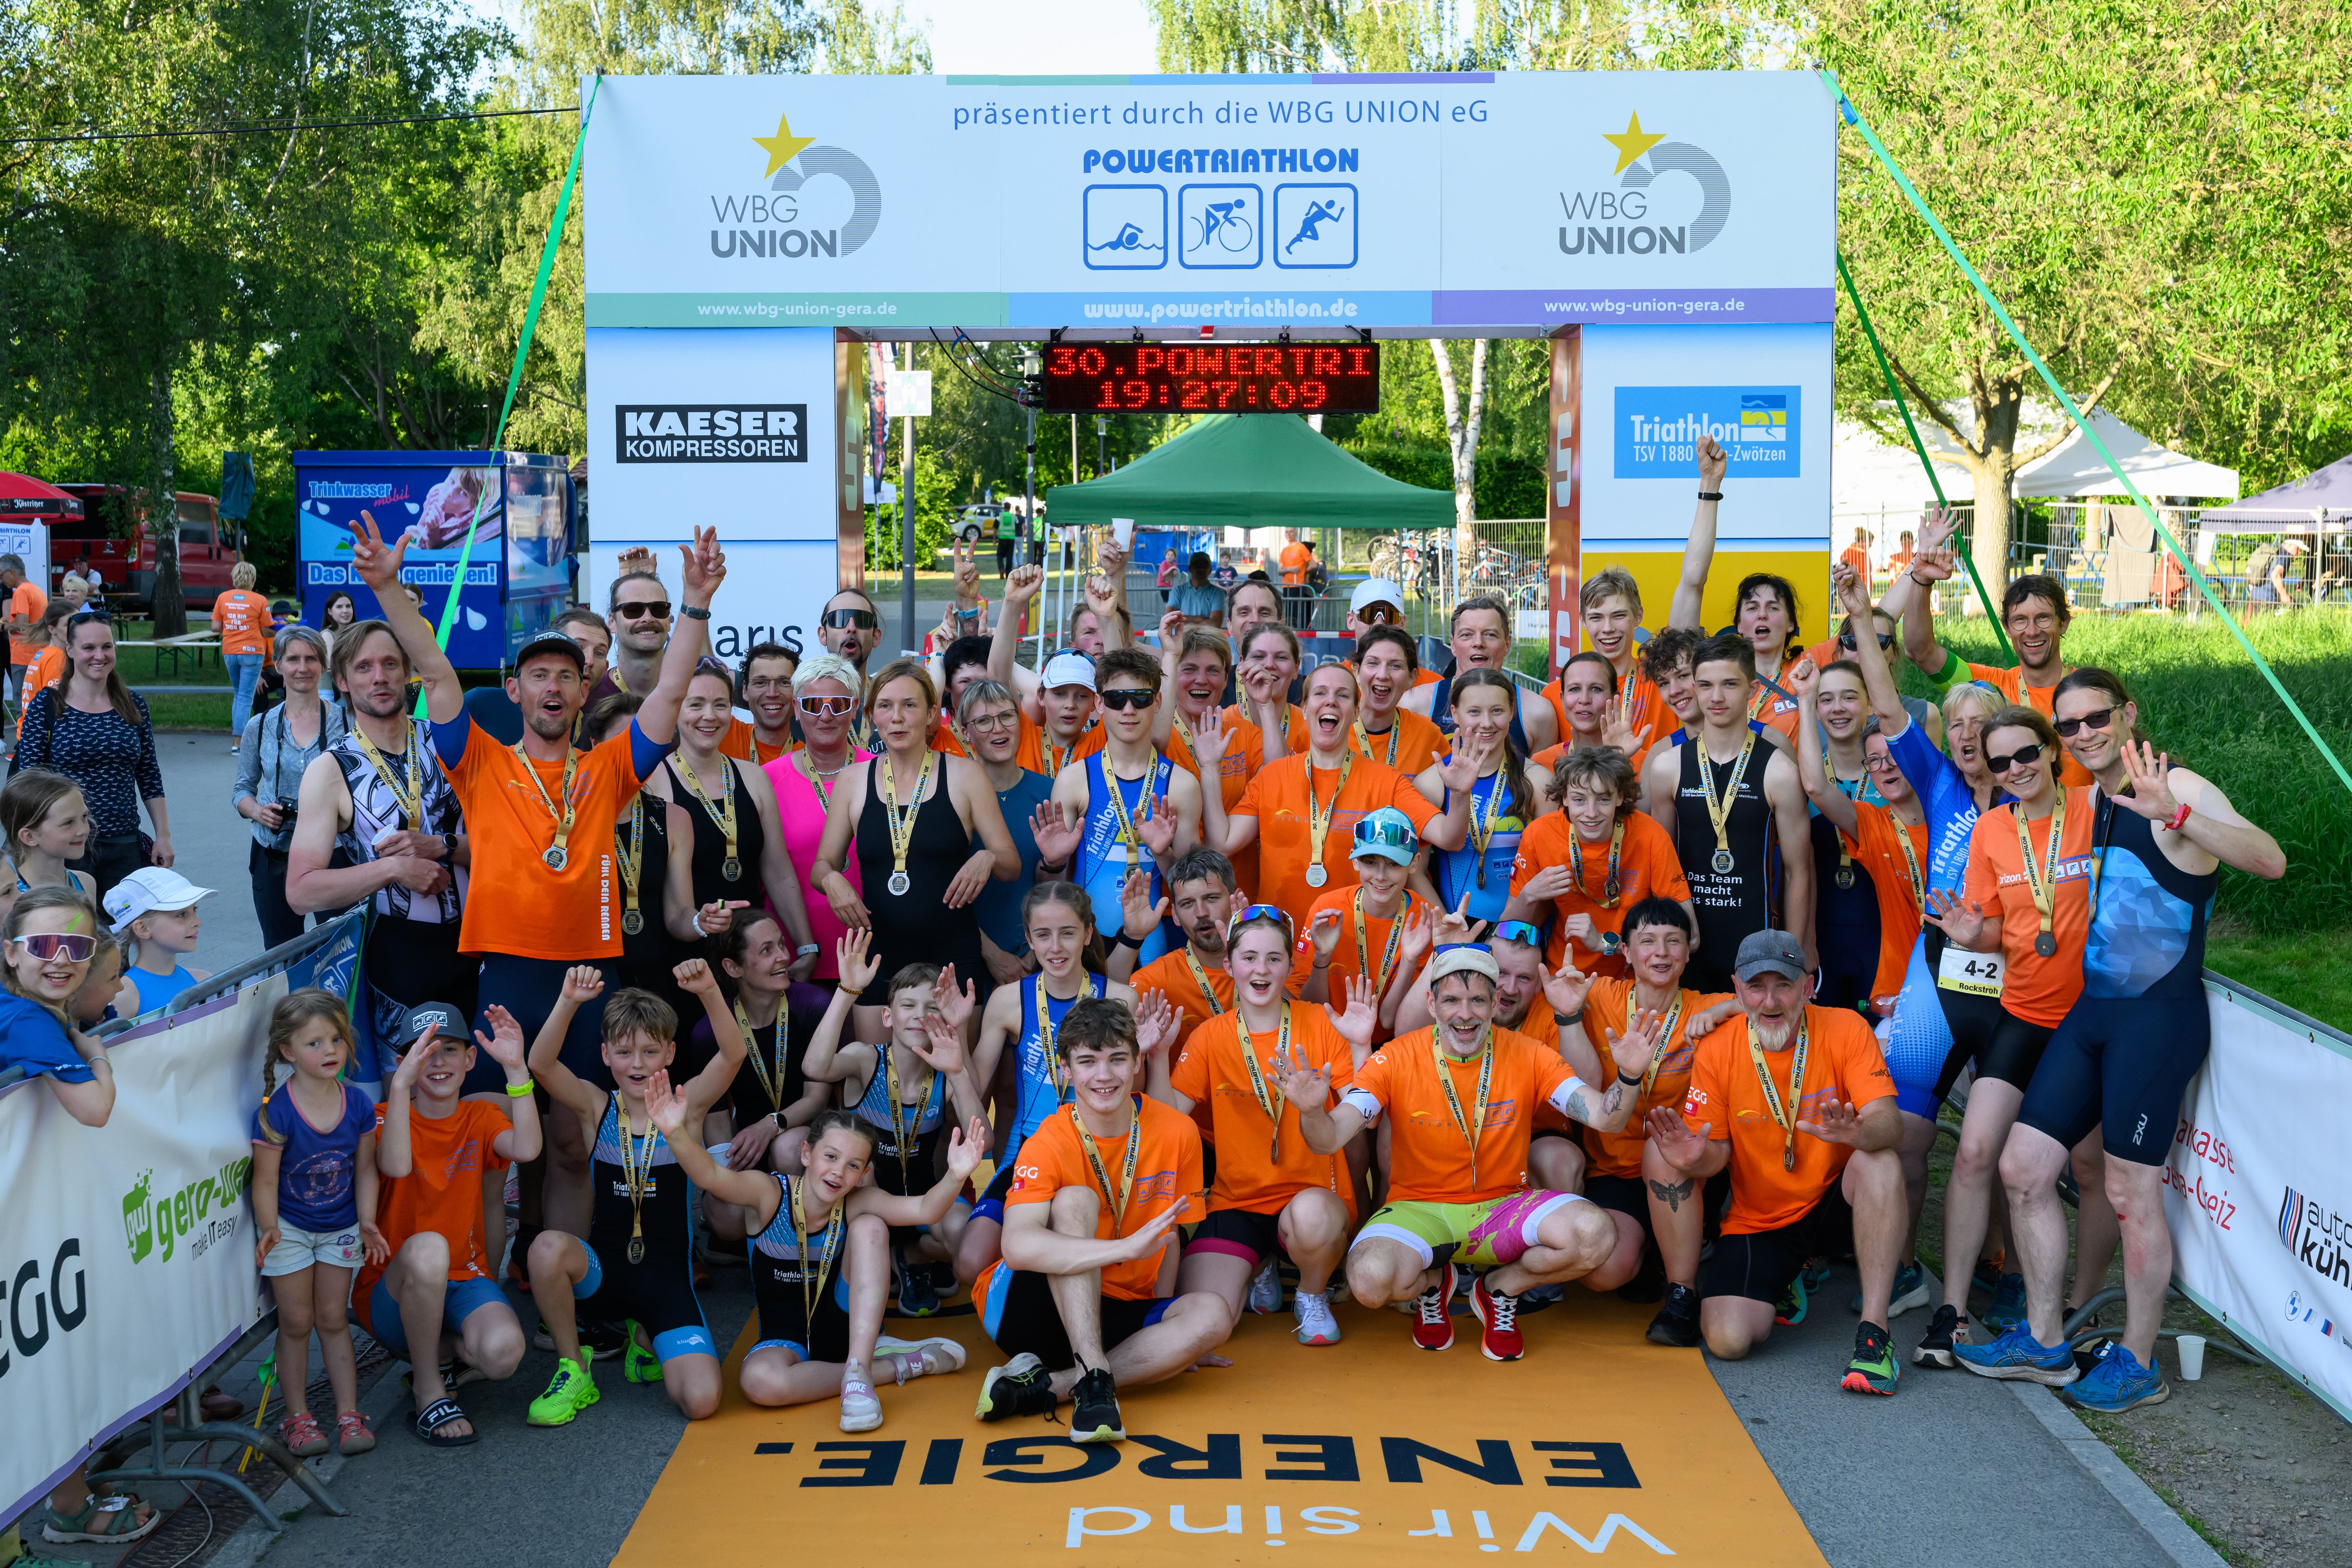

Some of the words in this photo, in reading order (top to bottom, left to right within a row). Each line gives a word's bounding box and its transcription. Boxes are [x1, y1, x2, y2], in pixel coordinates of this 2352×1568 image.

[954, 101, 1112, 130] präsentiert
[1123, 102, 1203, 125] durch
[1215, 101, 1258, 124] die
[1269, 100, 1334, 123] WBG
[1345, 100, 1439, 123] UNION
[1452, 100, 1488, 123] eG
[1083, 149, 1358, 173] POWERTRIATHLON
[711, 195, 798, 223] WBG
[1560, 191, 1647, 220] WBG
[711, 230, 837, 258] UNION
[1559, 226, 1686, 255] UNION
[698, 302, 897, 318] www.wbg-union-gera.de
[1085, 297, 1358, 322] www.powertriathlon.de
[1544, 297, 1745, 314] www.wbg-union-gera.de
[1049, 348, 1371, 375] 30.POWERTRI
[1098, 382, 1327, 408] 19:27:09
[626, 411, 797, 436] KAESER
[1631, 413, 1739, 442] Triathlon
[626, 440, 797, 457] KOMPRESSOREN
[1633, 445, 1655, 462] TSV
[1661, 445, 1693, 462] 1880
[1725, 445, 1786, 462] -Zwötzen
[309, 481, 392, 499] Trinkwasser
[373, 485, 410, 508] mobil
[310, 564, 345, 584] Das
[379, 765, 410, 812] POWERTRIATHLON
[724, 762, 732, 806] POWERTRIATHLON
[1140, 764, 1156, 813] POWERTRIATHLON
[1490, 770, 1506, 817] POWERTRIATHLON
[1703, 761, 1716, 808] POWERTRIATHLON
[1728, 750, 1749, 798] POWERTRIATHLON
[696, 788, 727, 832] POWERTRIATHLON
[887, 792, 900, 841] POWERTRIATHLON
[908, 774, 927, 821] POWERTRIATHLON
[1110, 786, 1131, 835] POWERTRIATHLON
[634, 805, 642, 853] POWERTRIATHLON
[649, 816, 664, 835] 2XU
[1087, 800, 1116, 855] Triathlon
[1098, 849, 1106, 860] TSV
[1102, 836, 1113, 852] 1880
[1931, 803, 1979, 875] Triathlo
[601, 855, 610, 877] FÜHL
[1688, 872, 1705, 882] Das
[1709, 873, 1742, 884] Team
[1905, 846, 1921, 894] POWERTRIATHLON
[1946, 866, 1956, 881] TSV
[1951, 849, 1965, 868] 1880
[2022, 836, 2037, 886] POWERTRIATHLON
[2047, 830, 2060, 884] POWERTRIATHLON
[601, 880, 609, 903] DEIN
[1693, 884, 1732, 895] macht
[1704, 897, 1741, 907] stark!
[601, 906, 610, 941] RENNEN
[1381, 925, 1401, 977] POWERTRIATHLON
[1965, 960, 1998, 979] 4-2
[1959, 982, 1999, 994] Rockstroh
[1043, 1026, 1054, 1081] POWERTRIATHLON
[1653, 1011, 1677, 1062] POWERTRIATHLON
[746, 1037, 767, 1086] POWERTRIATHLON
[1247, 1055, 1267, 1108] POWERTRIATHLON
[1479, 1052, 1491, 1108] POWERTRIATHLON
[1794, 1034, 1806, 1089] POWERTRIATHLON
[1444, 1079, 1466, 1132] POWERTRIATHLON
[1757, 1063, 1780, 1116] POWERTRIATHLON
[892, 1099, 903, 1151] POWERTRIATHLON
[910, 1087, 928, 1139] POWERTRIATHLON
[2132, 1113, 2148, 1146] 2XU
[621, 1127, 633, 1184] POWERTRIATHLON
[640, 1133, 654, 1191] POWERTRIATHLON
[1125, 1120, 1138, 1178] POWERTRIATHLON
[2176, 1118, 2235, 1174] arkasse
[1090, 1154, 1114, 1205] POWERTRIATHLON
[192, 1232, 208, 1261] make
[208, 1221, 216, 1245] IT
[217, 1214, 238, 1239] easy
[822, 1218, 839, 1276] POWERTRIATHLON
[2300, 1227, 2352, 1291] küh
[774, 1269, 803, 1278] Triathlo
[845, 1382, 867, 1393] NIKE
[428, 1405, 463, 1423] FILA
[755, 1434, 1642, 1489] ENERGIE.
[1066, 1504, 1361, 1550] sind
[1409, 1509, 1676, 1555] Wir
